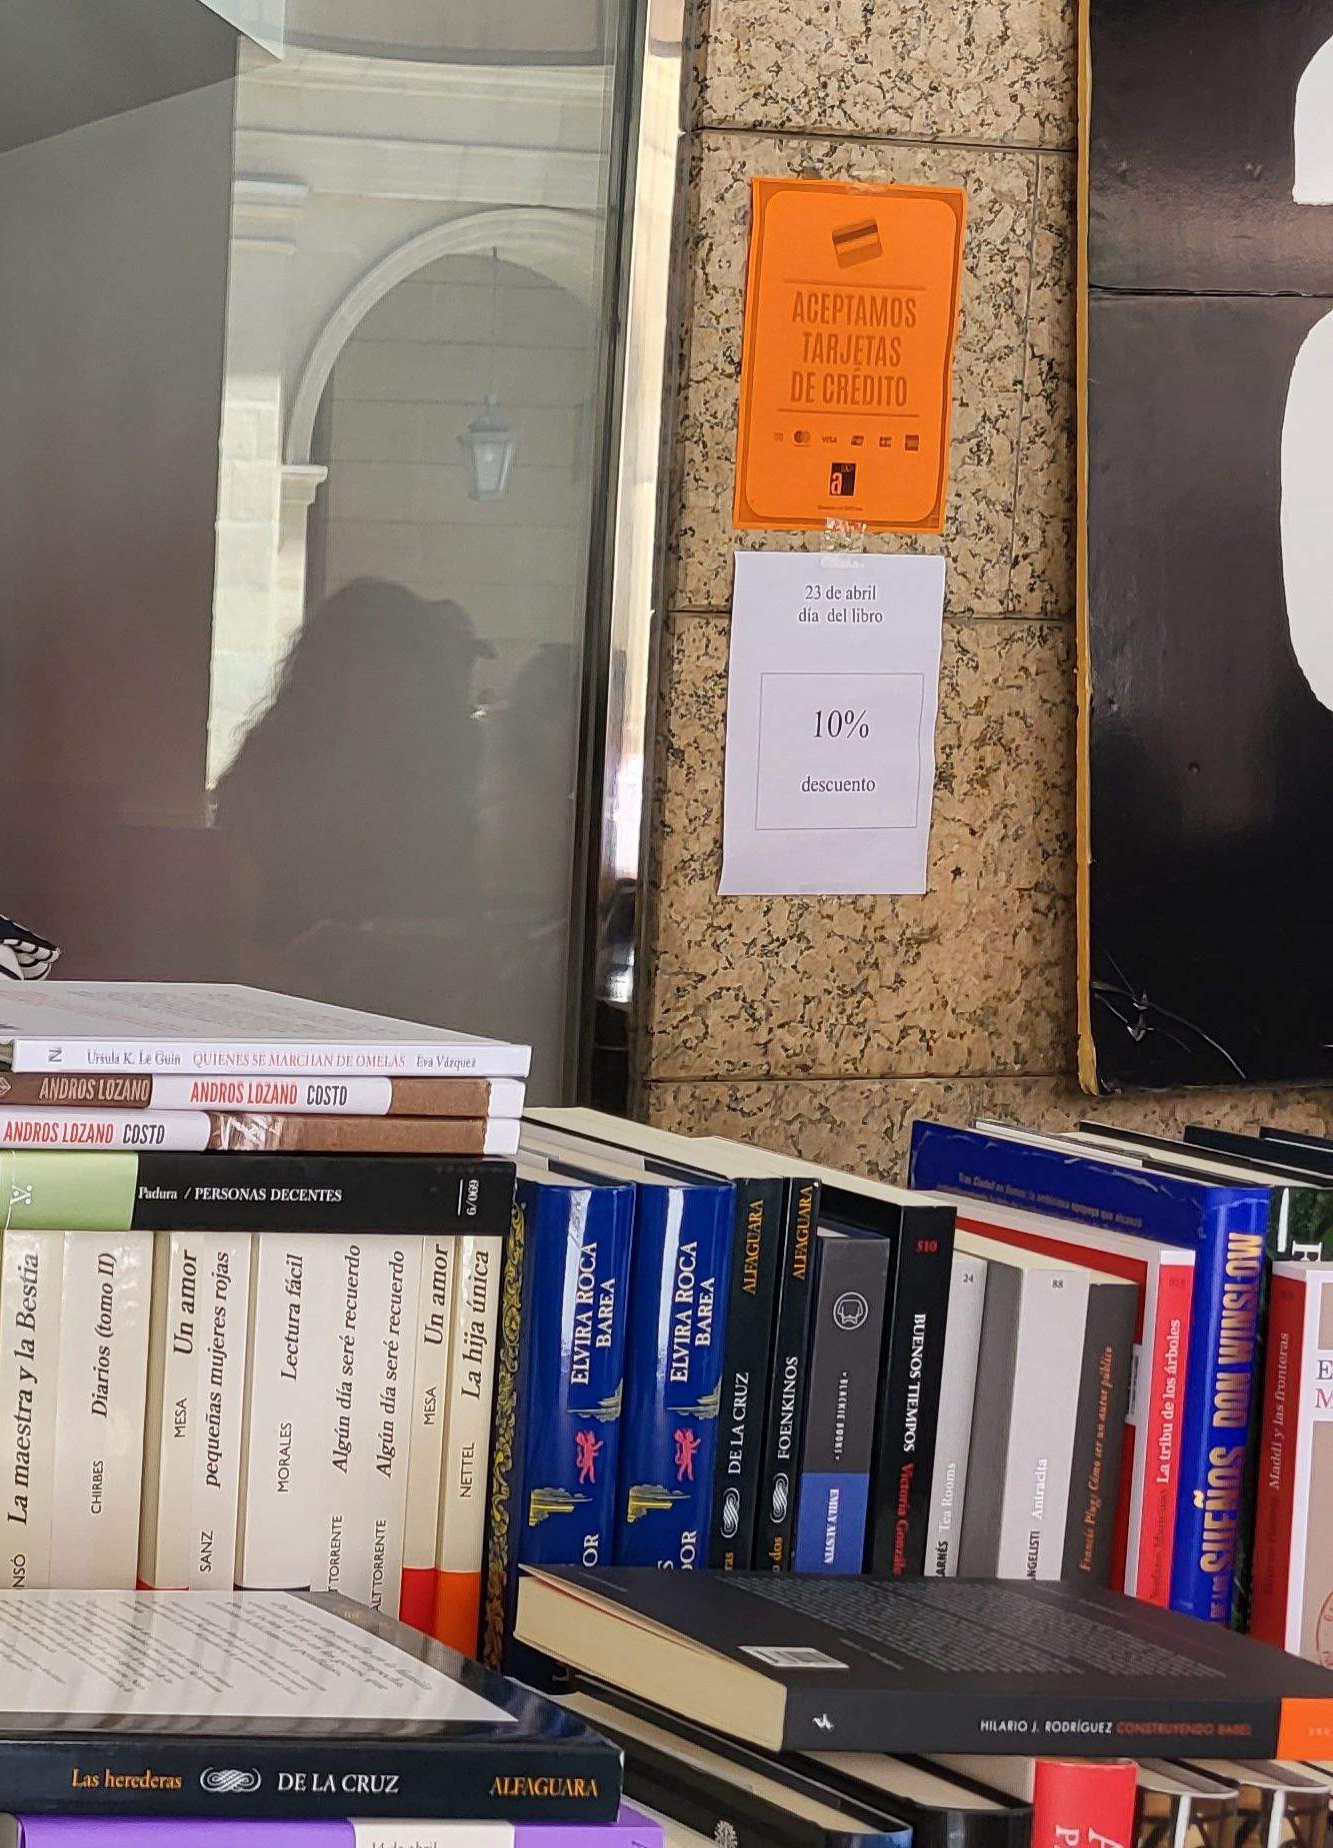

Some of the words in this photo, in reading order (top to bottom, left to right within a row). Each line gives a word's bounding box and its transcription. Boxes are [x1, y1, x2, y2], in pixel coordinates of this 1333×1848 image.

[792, 290, 917, 328] ACEPTAMOS
[802, 331, 902, 367] TARJETAS
[790, 371, 815, 403] DE
[822, 368, 908, 407] CRÉDITO
[798, 608, 819, 623] día
[827, 608, 846, 623] del
[852, 608, 883, 623] libro
[805, 585, 821, 600] 23
[826, 585, 841, 600] de
[846, 585, 876, 600] abril
[814, 709, 869, 739] 10%
[801, 776, 876, 793] descuento
[192, 1052, 249, 1068] QUIENES
[269, 1053, 332, 1068] MARCHAN
[355, 1053, 406, 1069] OMELAS
[38, 1076, 94, 1100] ANDROS
[98, 1076, 150, 1101] LOZANO
[190, 1080, 244, 1105] ANDROS
[247, 1081, 298, 1106] LOZANO
[306, 1085, 348, 1107] COSTO
[3, 1121, 60, 1144] ANDROS
[63, 1122, 114, 1145] LOZANO
[122, 1124, 166, 1145] COSTO
[138, 1186, 178, 1201] Padura
[194, 1187, 267, 1201] PERSONAS
[270, 1189, 343, 1203] DECENTES
[180, 1250, 200, 1317] amor
[470, 1250, 490, 1303] única
[575, 1242, 598, 1303] ROCA
[675, 1241, 698, 1302] ROCA
[962, 1274, 974, 1284] 24
[1052, 1280, 1064, 1289] 88
[1218, 1231, 1264, 1366] WINSLOW
[172, 1322, 194, 1355] Un
[280, 1294, 303, 1381] Lectura
[595, 1277, 616, 1349] BAREA
[694, 1277, 716, 1347] BAREA
[731, 1372, 750, 1424] CRUZ
[742, 1197, 764, 1296] ALFAGUARA
[777, 1355, 799, 1460] FOENKINOS
[791, 1185, 814, 1282] ALFAGUARA
[210, 1306, 228, 1388] mujeres
[331, 1410, 351, 1474] Algún
[343, 1244, 361, 1327] recuerdo
[570, 1306, 596, 1386] ELVIRA
[669, 1305, 694, 1383] ELVIRA
[910, 1313, 926, 1381] BUENOS
[1275, 1332, 1289, 1400] fronteras
[90, 1344, 111, 1419] Diarios
[461, 1362, 481, 1401] La
[1212, 1372, 1251, 1428] DON
[173, 1396, 187, 1438] MESA
[204, 1391, 223, 1489] pequeñas
[902, 1383, 924, 1453] TIEMPOS
[276, 1421, 294, 1494] MORALES
[459, 1441, 476, 1499] NETTEL
[1269, 1442, 1283, 1490] Maddi
[90, 1459, 104, 1515] CHIRBES
[1032, 1458, 1048, 1520] Antracita
[1193, 1446, 1247, 1574] SUEÑOS
[199, 1529, 214, 1573] SANZ
[980, 1719, 1028, 1733] HILARIO
[1045, 1719, 1112, 1735] RODRÍGUEZ
[71, 1766, 101, 1791] Las
[104, 1766, 183, 1793] herederas
[341, 1774, 400, 1794] CRUZ
[488, 1775, 599, 1798] ALFAGUARA
